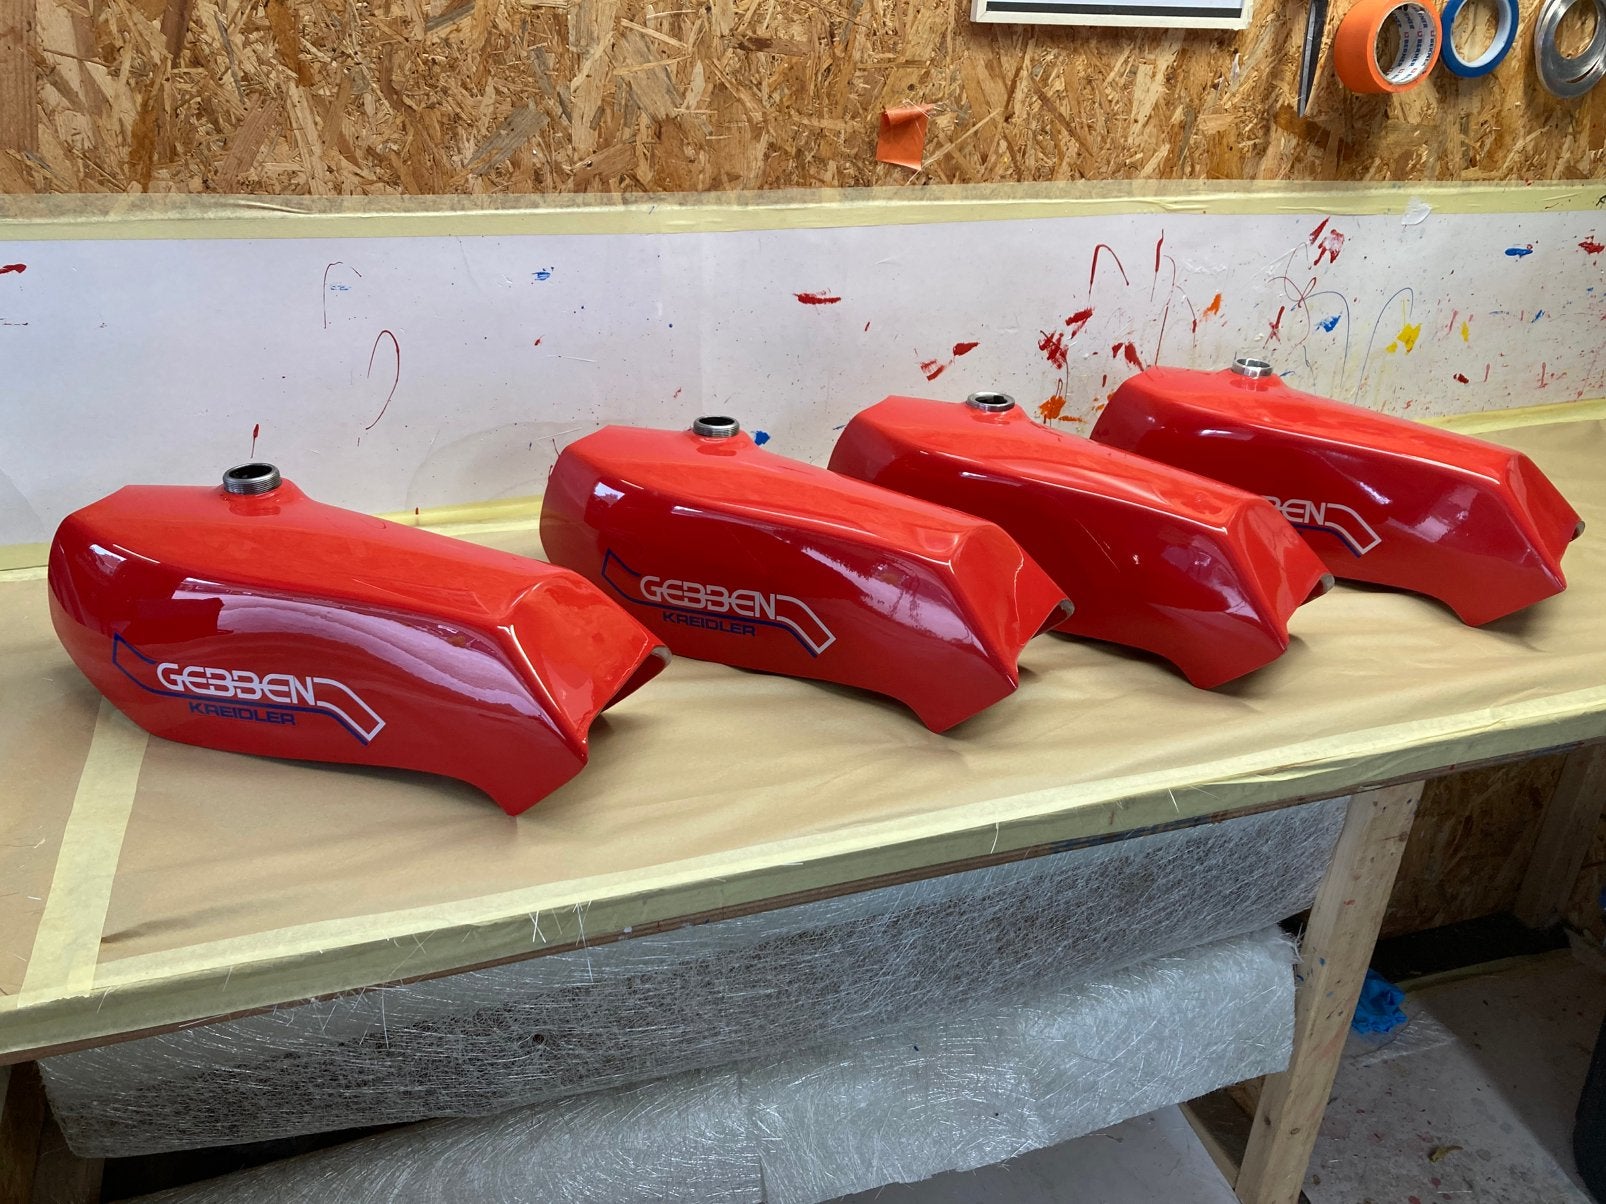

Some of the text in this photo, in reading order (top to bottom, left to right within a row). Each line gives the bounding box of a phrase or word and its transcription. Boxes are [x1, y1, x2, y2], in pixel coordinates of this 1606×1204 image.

[1410, 39, 1422, 67] BERNER
[640, 575, 776, 620] GEBBEN
[662, 611, 756, 637] KREIDLER
[157, 662, 315, 705] GEBBEN
[189, 701, 296, 725] KREIDLER
